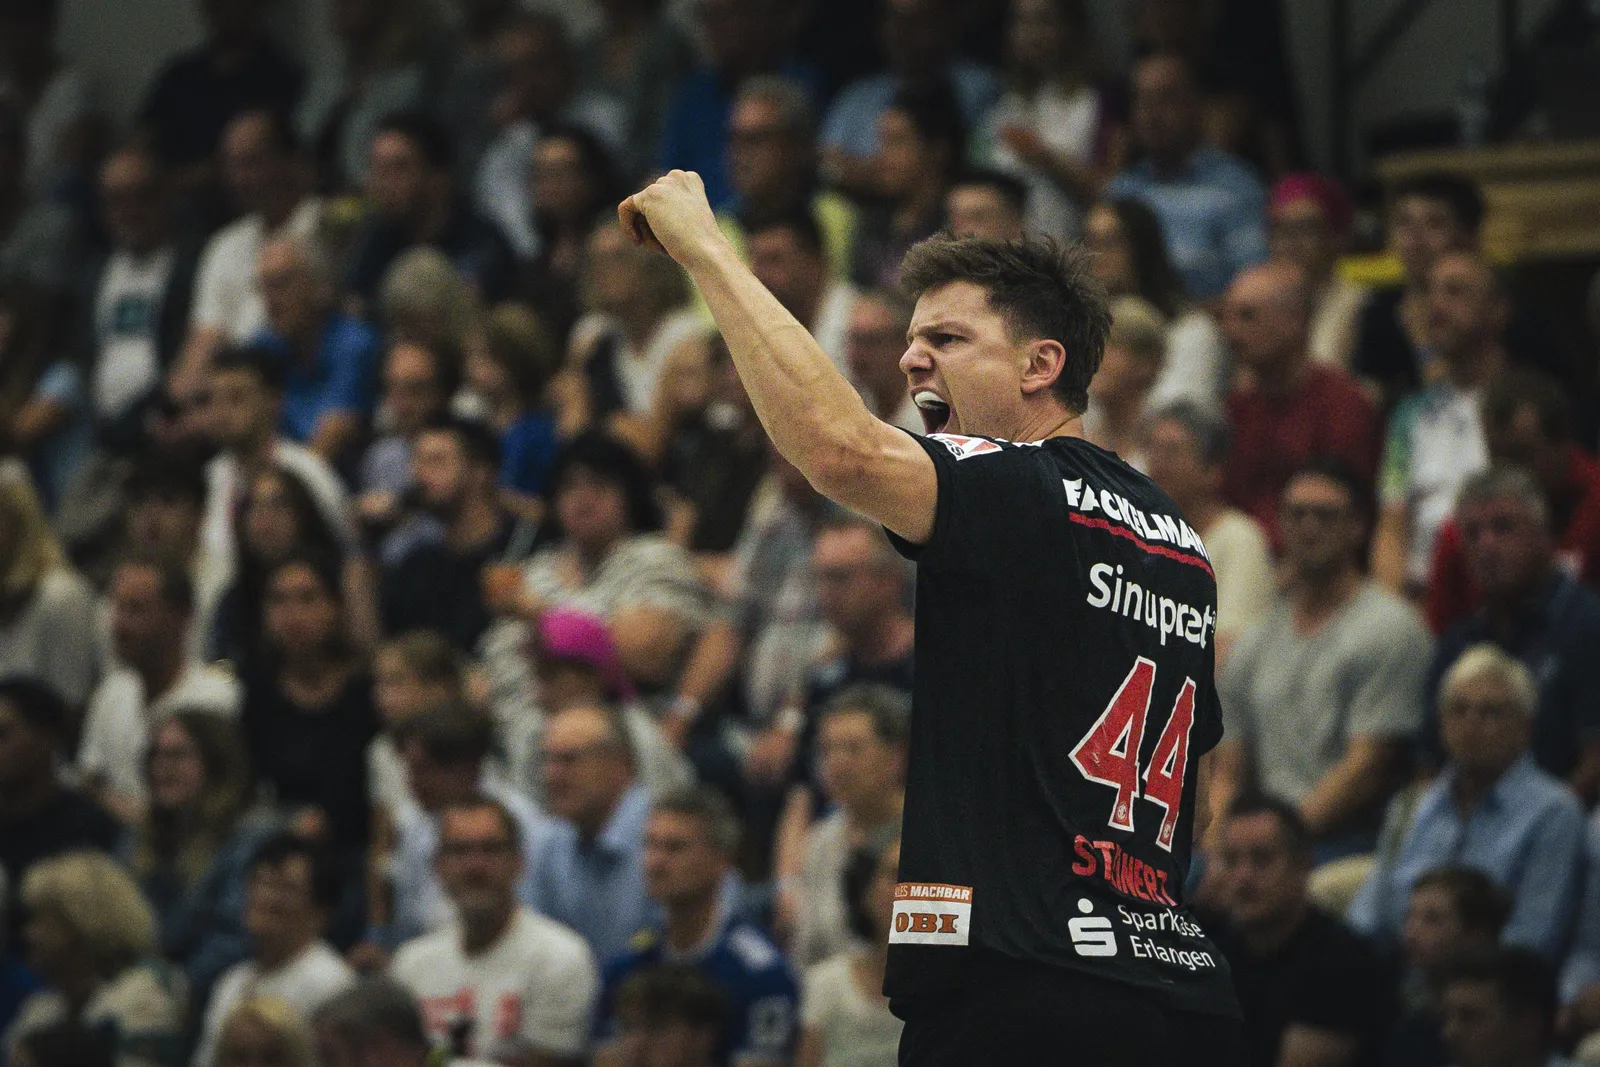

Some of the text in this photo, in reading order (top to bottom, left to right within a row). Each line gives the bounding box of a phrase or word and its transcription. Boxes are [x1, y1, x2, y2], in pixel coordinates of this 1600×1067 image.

[1086, 563, 1212, 650] Sinupret
[1068, 655, 1196, 853] 44
[910, 885, 970, 901] MACHBAR
[895, 912, 959, 934] OBI
[1129, 935, 1216, 971] Erlangen
